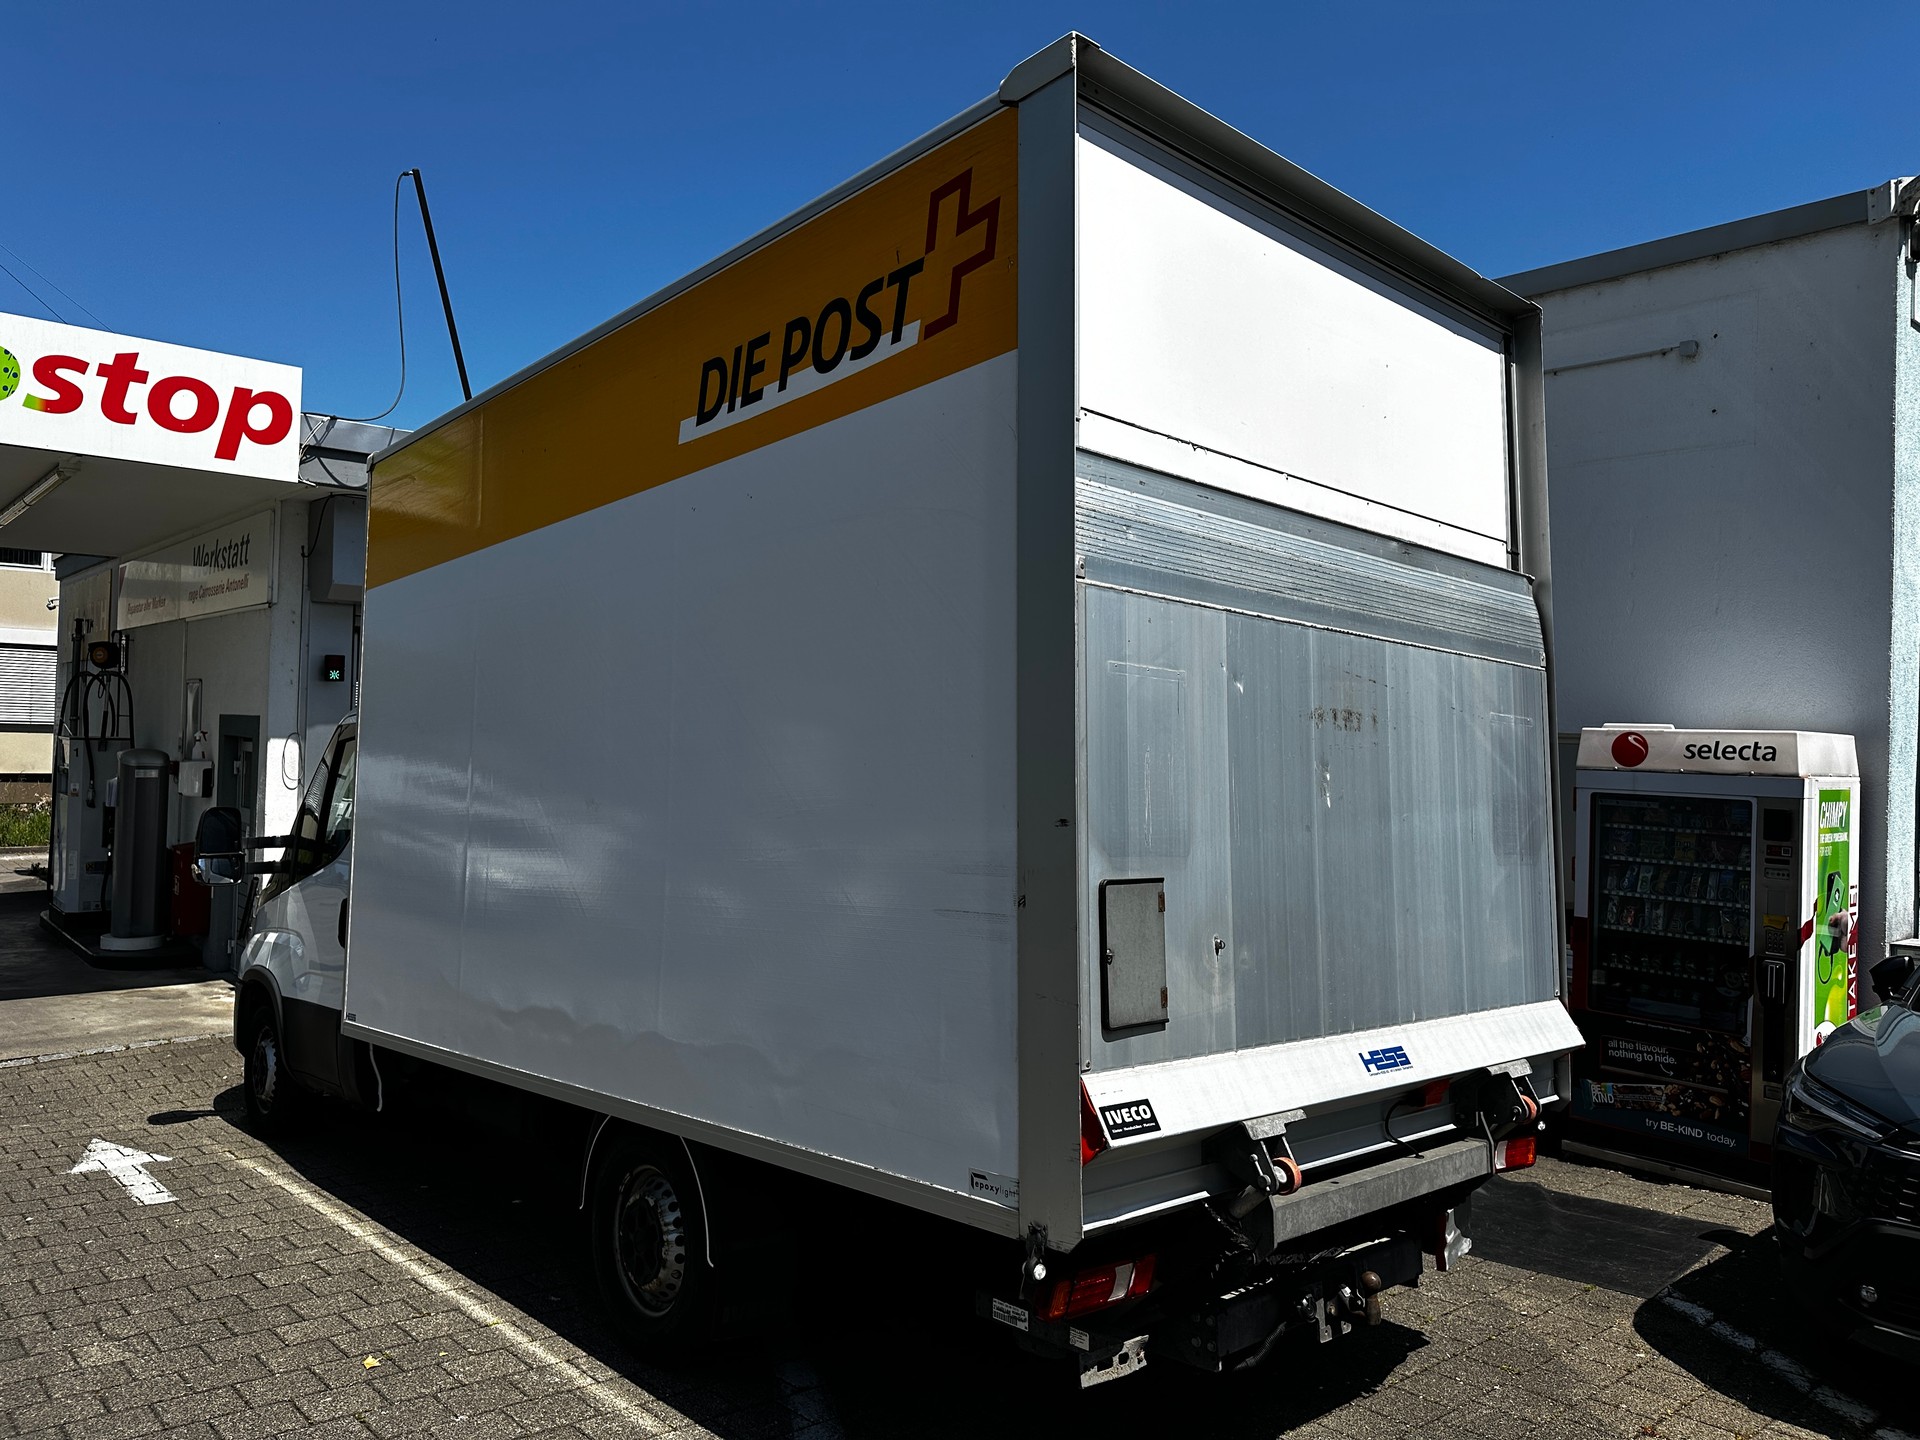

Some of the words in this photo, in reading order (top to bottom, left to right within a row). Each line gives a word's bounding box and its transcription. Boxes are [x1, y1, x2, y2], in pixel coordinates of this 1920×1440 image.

[696, 331, 771, 427] DIE
[778, 256, 925, 393] POST
[22, 352, 293, 461] stop
[193, 533, 250, 577] Werkstatt
[1683, 741, 1777, 761] selecta
[1820, 801, 1848, 828] CHIMPY
[1849, 885, 1857, 939] ME!
[1848, 942, 1856, 1017] TAKE
[1608, 1039, 1617, 1048] all
[1619, 1040, 1634, 1050] the
[1608, 1049, 1642, 1062] nothing
[1643, 1052, 1653, 1062] to
[1654, 1053, 1677, 1065] hide.
[1358, 1046, 1411, 1073] HESS
[1592, 1093, 1615, 1104] KIND
[1105, 1104, 1152, 1126] IVECO
[1646, 1117, 1659, 1130] try
[1706, 1131, 1737, 1148] today.
